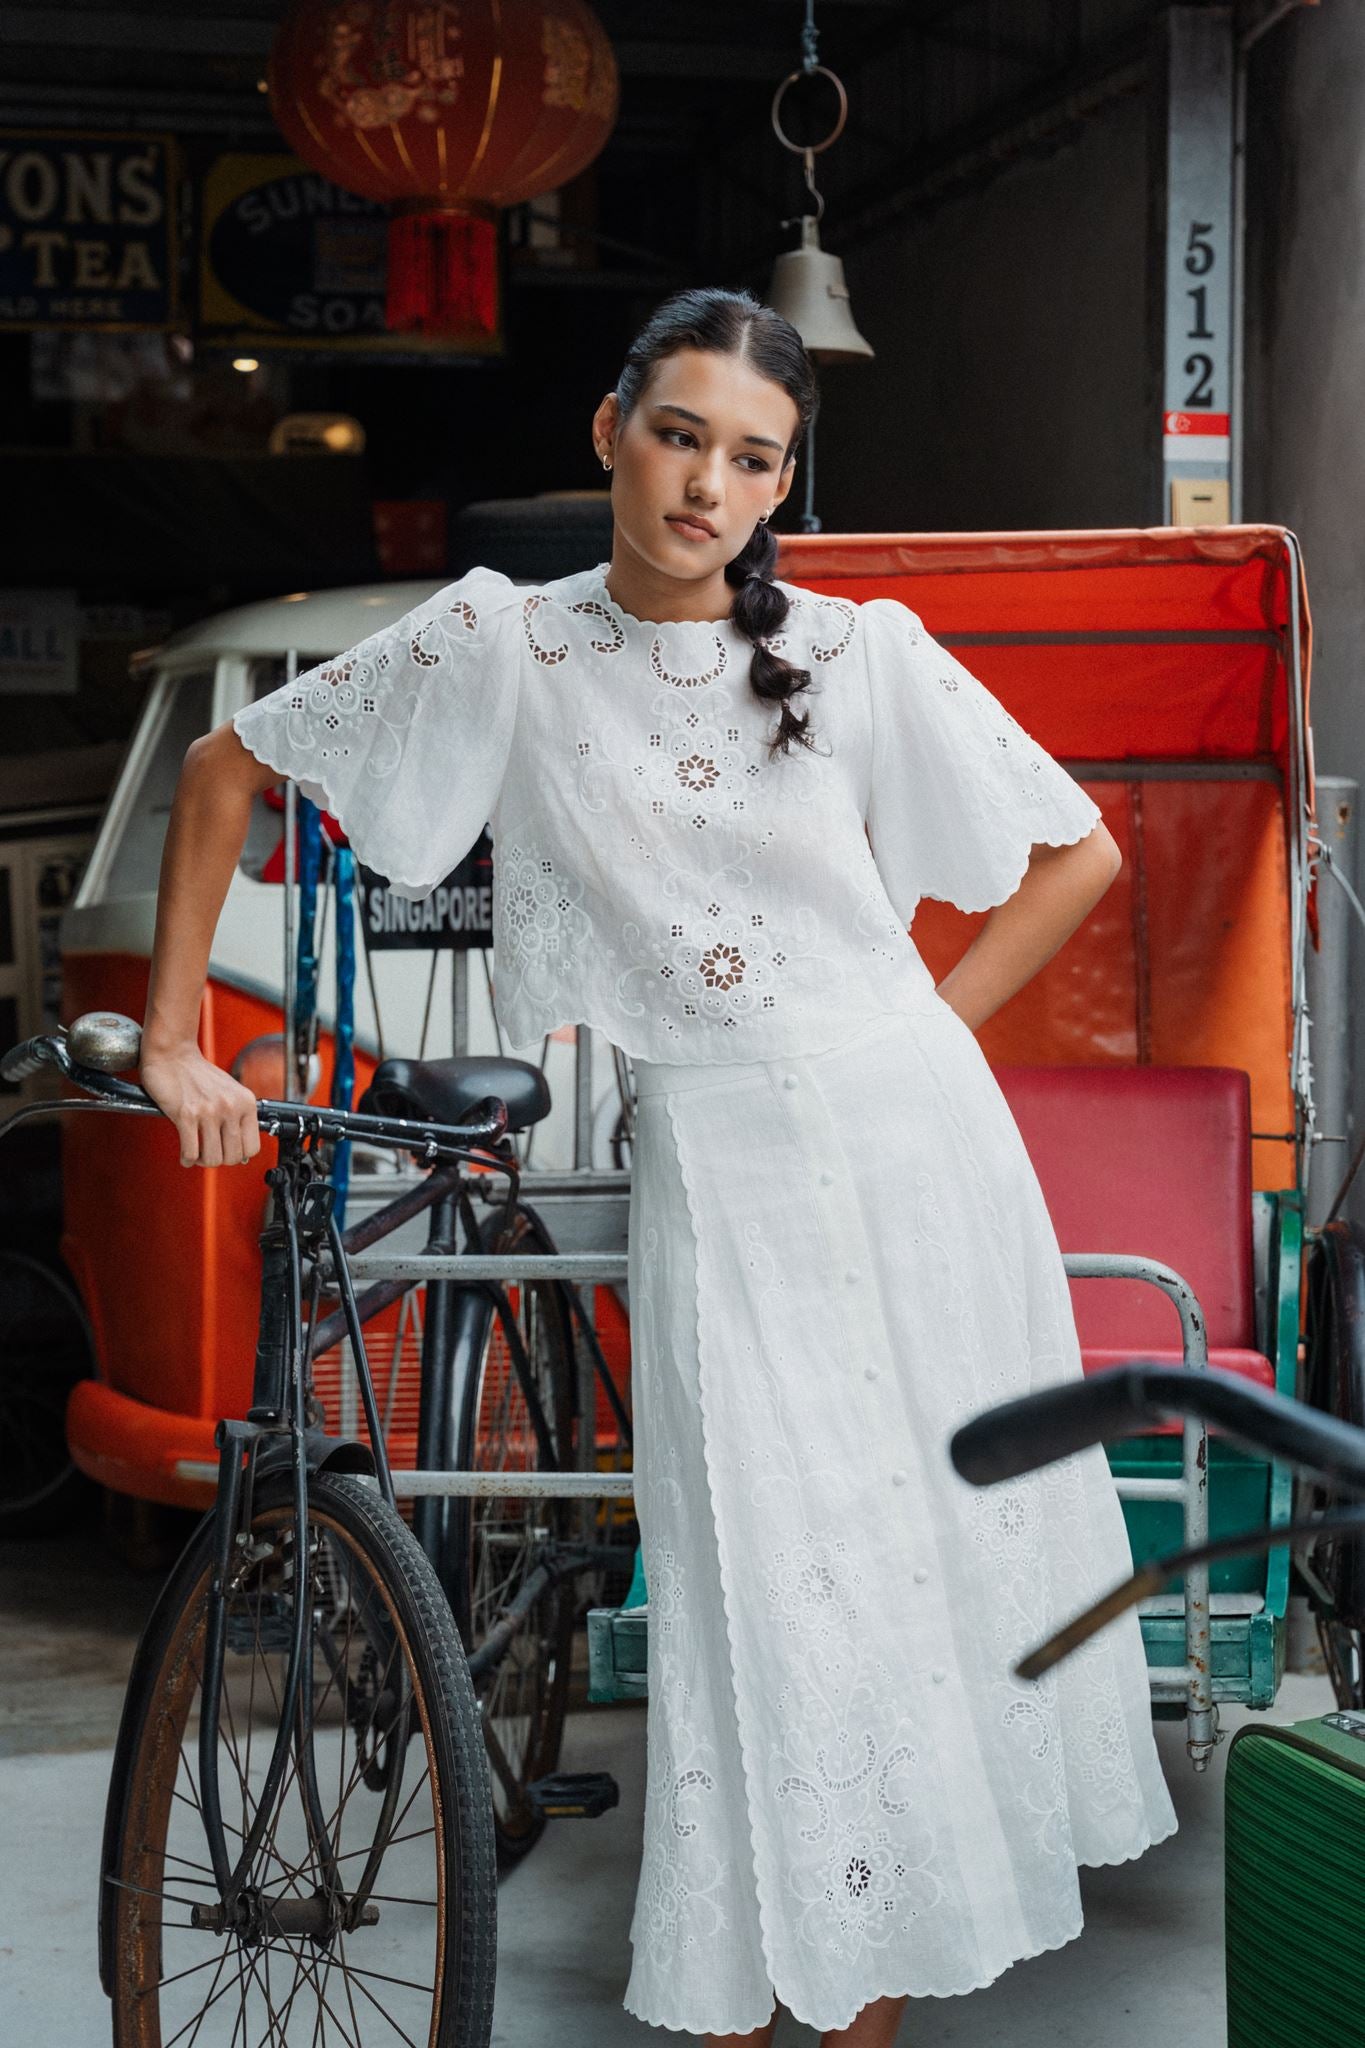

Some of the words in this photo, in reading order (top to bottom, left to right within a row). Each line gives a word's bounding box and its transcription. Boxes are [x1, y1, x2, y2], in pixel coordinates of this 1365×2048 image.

[21, 230, 162, 290] TEA
[1185, 222, 1214, 407] 512
[369, 885, 492, 934] SINGAPORE
